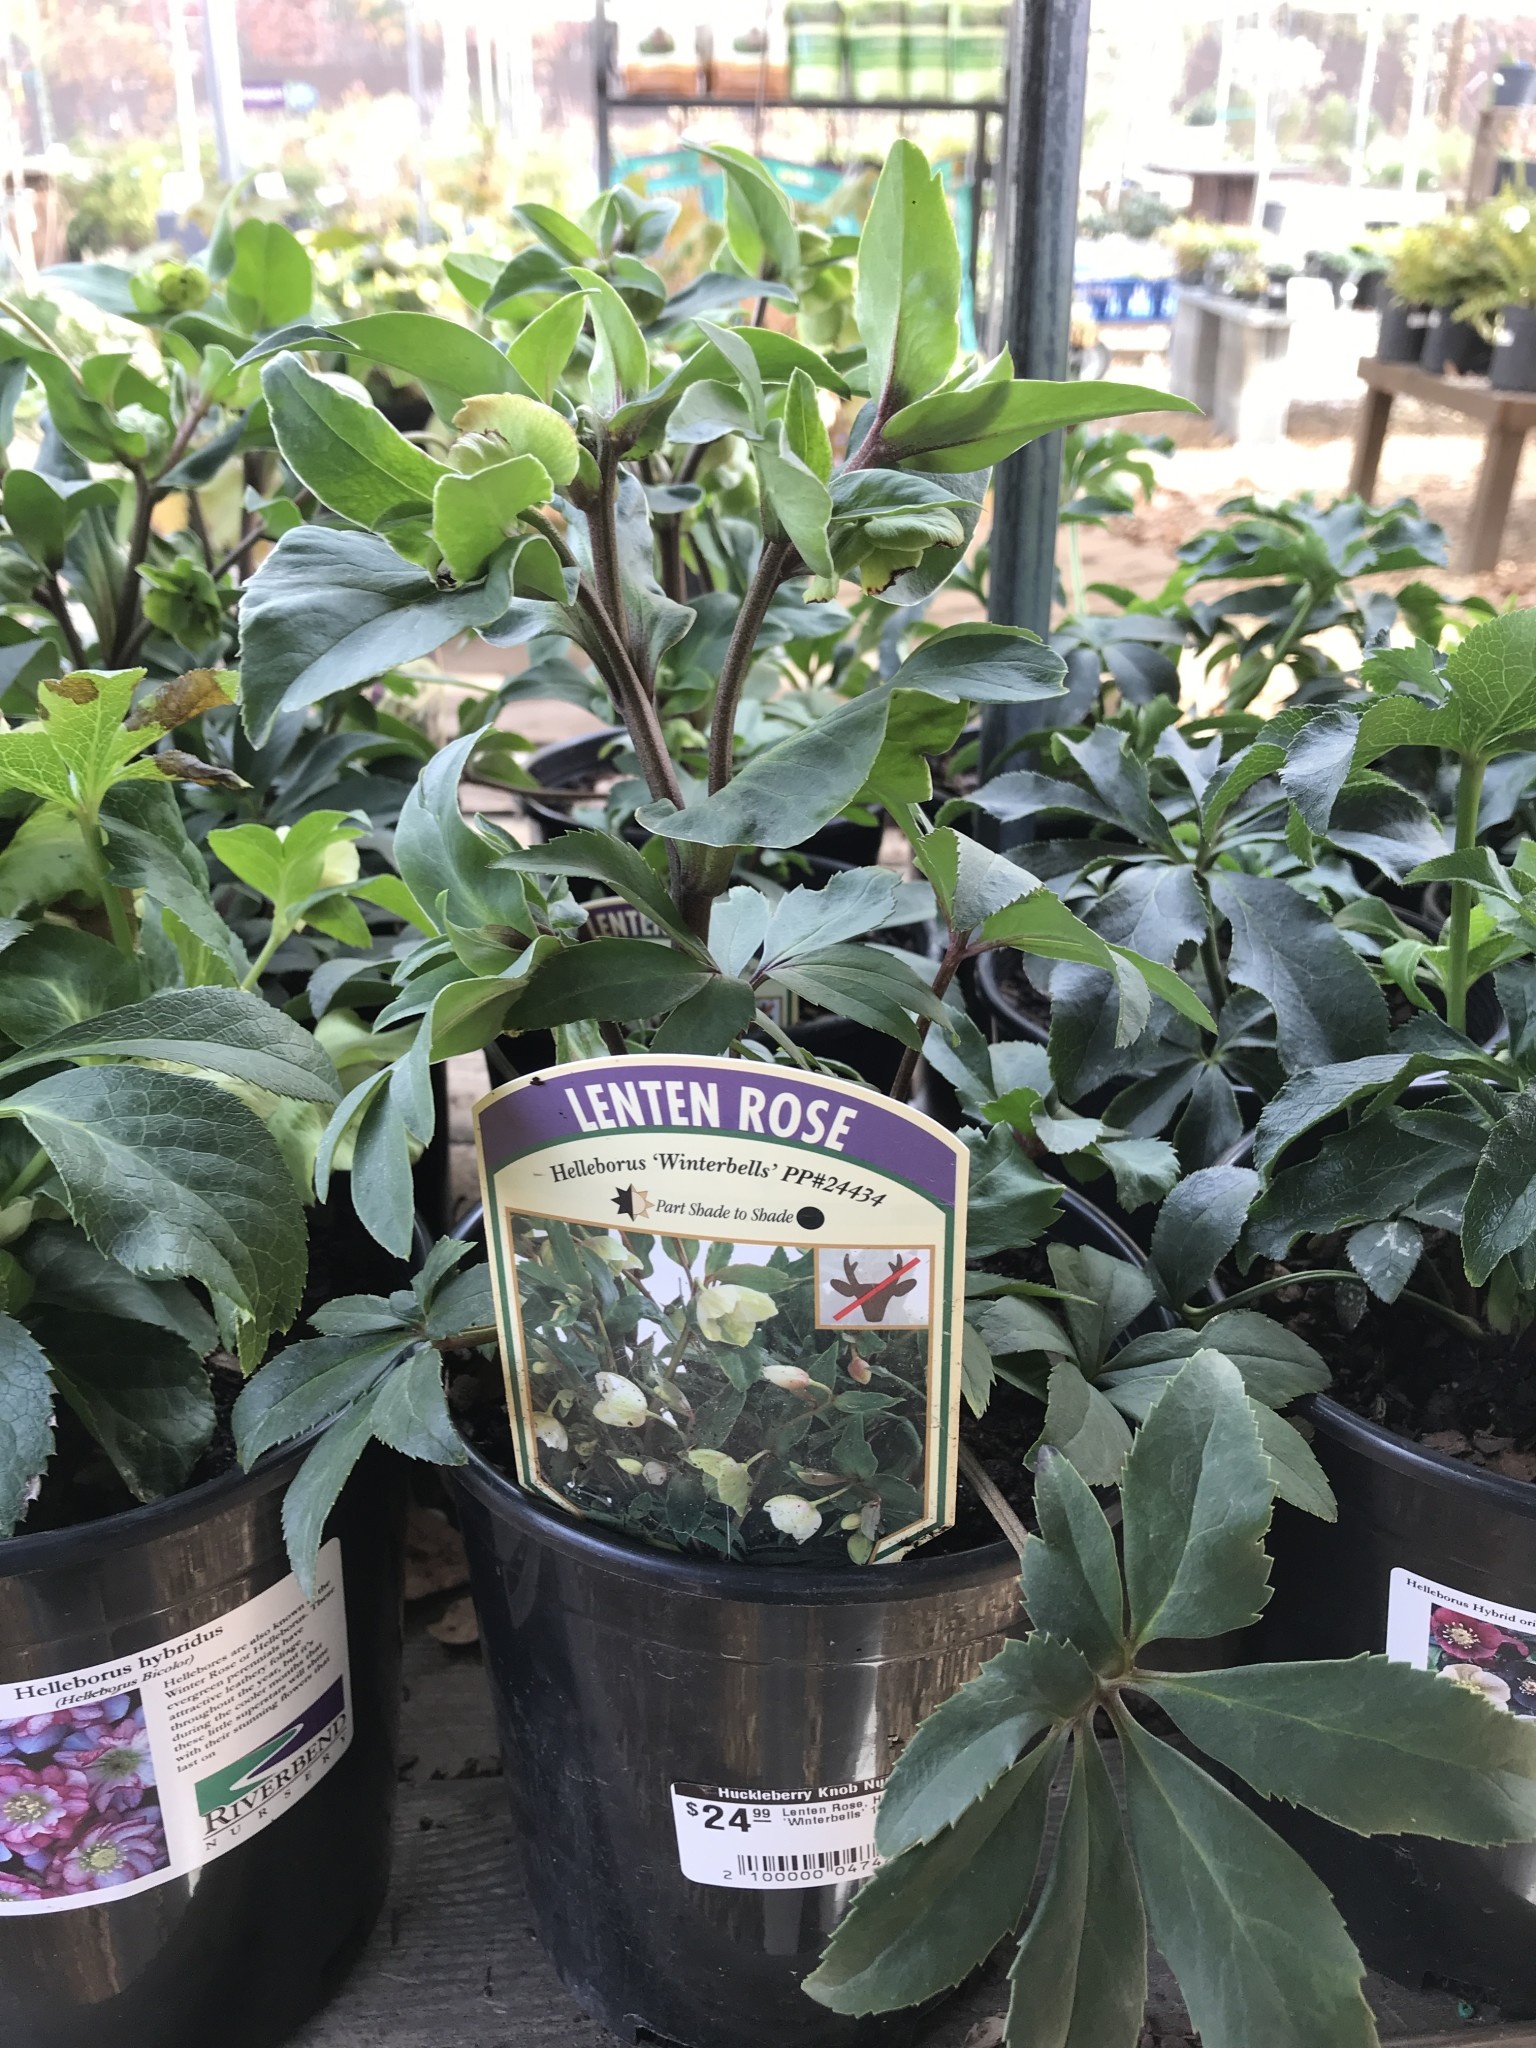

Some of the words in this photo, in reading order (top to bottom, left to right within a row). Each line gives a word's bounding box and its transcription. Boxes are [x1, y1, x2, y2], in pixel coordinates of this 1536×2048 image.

[565, 1080, 720, 1133] LENTEN
[738, 1085, 859, 1152] ROSE
[550, 1156, 647, 1183] Helleborus
[782, 1166, 887, 1208] PP#24434
[655, 1199, 686, 1216] Part
[688, 1202, 732, 1220] Shade
[735, 1206, 748, 1221] to
[750, 1207, 794, 1224] Shade
[1406, 1577, 1469, 1609] Helleborus
[1473, 1603, 1516, 1622] Hybrid
[14, 1664, 132, 1700] Helleborus
[138, 1625, 224, 1669] hybridus
[55, 1678, 138, 1709] (Helleborus
[142, 1653, 195, 1683] Bicolor)
[164, 1655, 227, 1688] Hellebores
[231, 1644, 247, 1656] are
[250, 1629, 271, 1646] also
[273, 1603, 305, 1630] known
[165, 1677, 206, 1698] Winter
[209, 1661, 236, 1680] Rose
[239, 1652, 250, 1663] or
[167, 1680, 224, 1710] evergreen
[226, 1645, 280, 1684] perennials
[282, 1627, 304, 1646] have
[169, 1692, 222, 1721] attractive
[225, 1665, 266, 1693] leathery
[269, 1639, 301, 1666] foliage
[170, 1695, 235, 1732] throughout
[237, 1684, 254, 1698] the
[283, 1652, 299, 1668] but
[172, 1720, 212, 1742] during
[214, 1708, 232, 1722] the
[235, 1687, 266, 1711] cooler
[269, 1660, 304, 1688] months
[306, 1642, 323, 1660] that
[174, 1735, 205, 1752] these
[208, 1719, 233, 1737] little
[235, 1684, 287, 1721] superstars
[289, 1667, 305, 1684] will
[307, 1647, 329, 1670] shine
[176, 1747, 202, 1762] with
[204, 1731, 231, 1750] their
[233, 1700, 278, 1734] stunning
[281, 1674, 313, 1702] flowers
[314, 1656, 330, 1674] that
[177, 1759, 198, 1773] last
[201, 1750, 216, 1762] on
[204, 1713, 346, 1835] RIVERBEND
[718, 1786, 812, 1802] Huckleberry
[818, 1783, 859, 1799] Knob
[782, 1806, 826, 1817] Lenten
[752, 1869, 824, 1882] 100000
[835, 1857, 885, 1876] 0474
